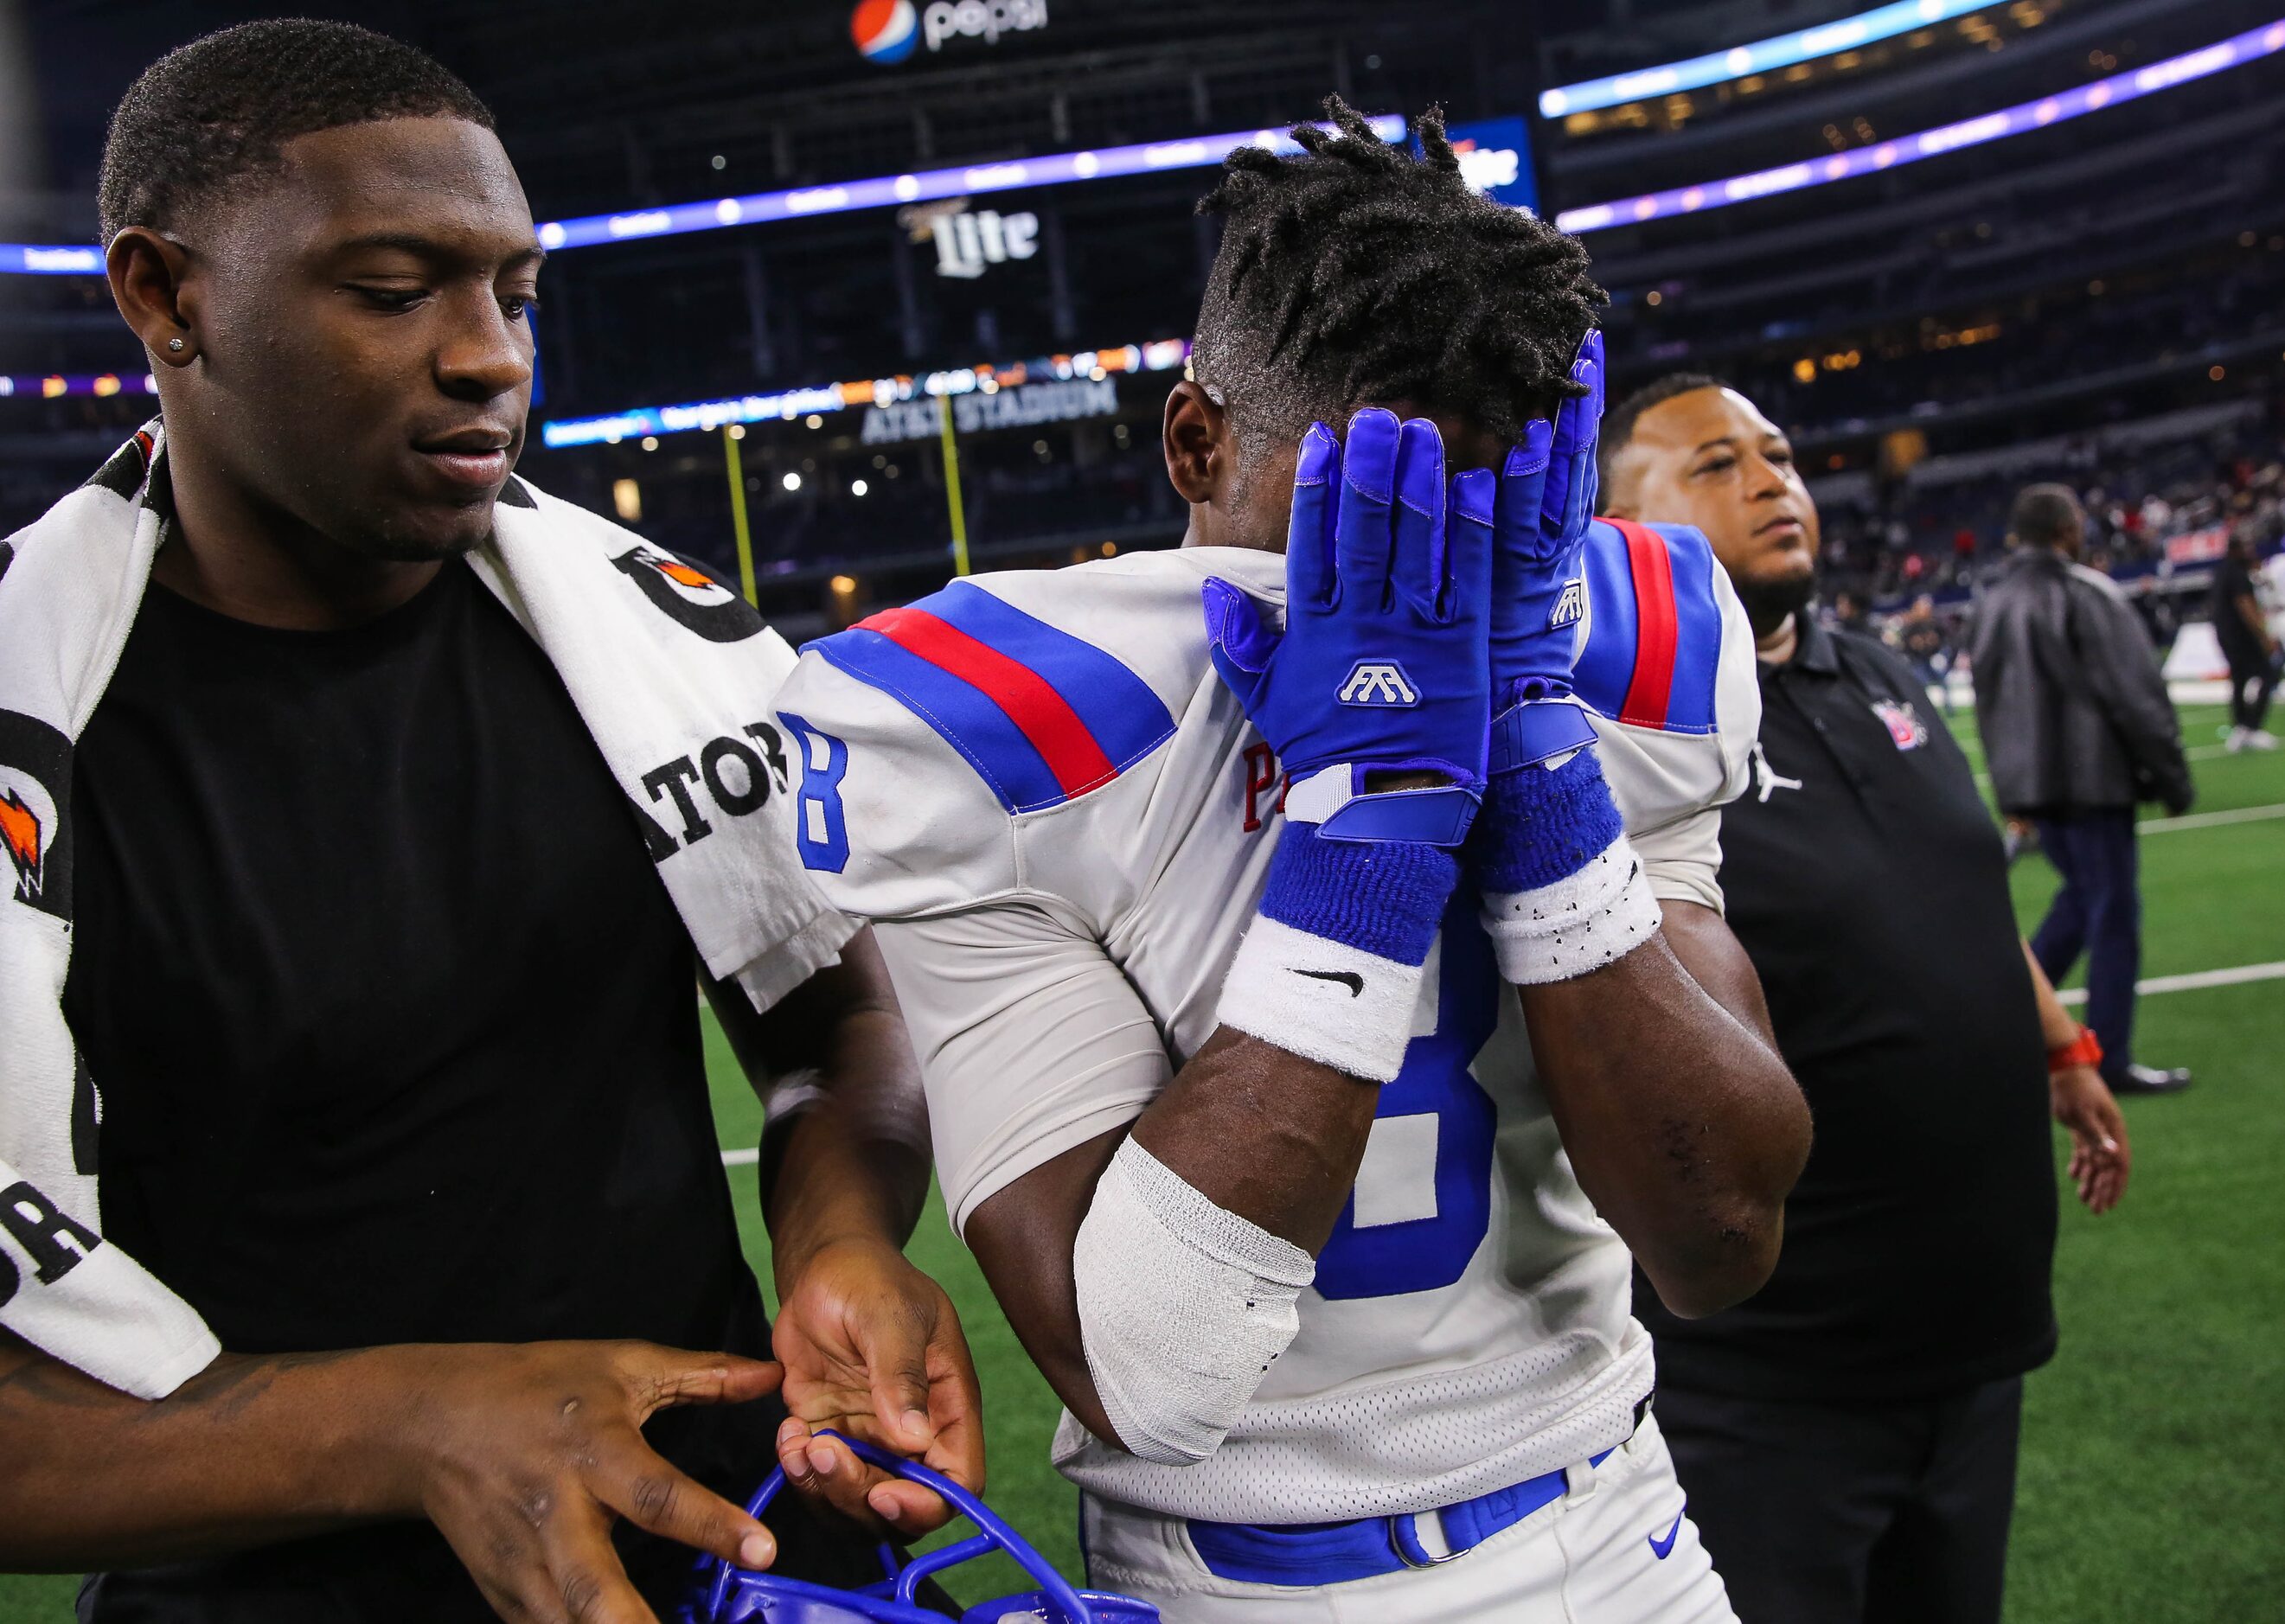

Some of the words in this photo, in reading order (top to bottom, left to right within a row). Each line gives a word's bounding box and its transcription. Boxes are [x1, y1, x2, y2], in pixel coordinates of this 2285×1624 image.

[924, 0, 1047, 52] pepsi
[932, 210, 1039, 278] Lite
[955, 378, 1118, 433] STADIUM
[776, 711, 850, 874] 8
[1243, 741, 1290, 833] P
[1311, 886, 1501, 1301] 8
